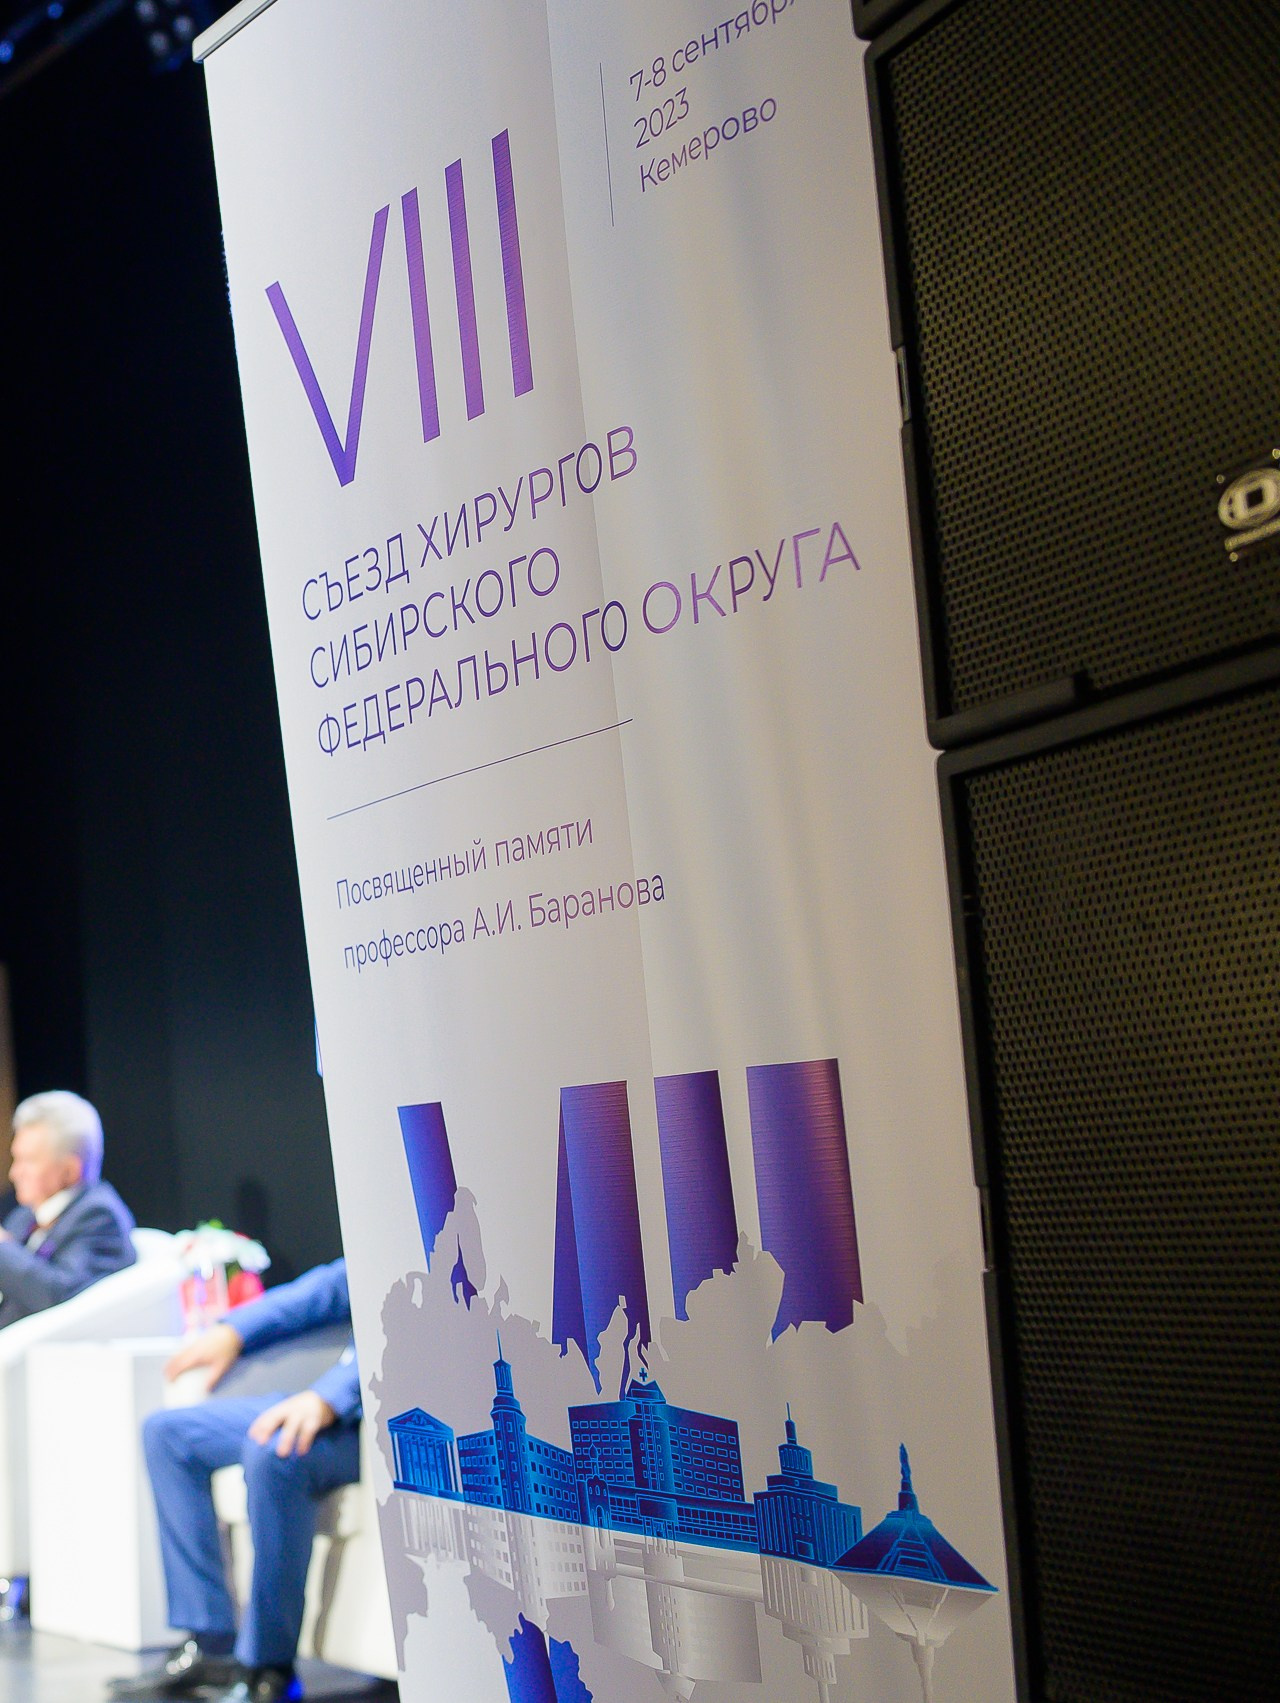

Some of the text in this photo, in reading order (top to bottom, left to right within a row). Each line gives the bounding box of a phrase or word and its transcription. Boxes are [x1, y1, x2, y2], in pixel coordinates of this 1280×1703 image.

[629, 0, 795, 101] 7-8 сентябр
[633, 87, 690, 149] 2023
[639, 98, 778, 193] Кемерово
[265, 128, 534, 487] VIII
[302, 425, 639, 621] СЪЕЗД ХИРУРГОВ
[309, 546, 561, 688] СИБИРСКОГО
[317, 521, 862, 757] ФЕДЕРАЛЬНОГО ОКРУГА
[336, 818, 594, 910] Посвященный памяти
[343, 874, 665, 974] профессора А.И. Баранова
